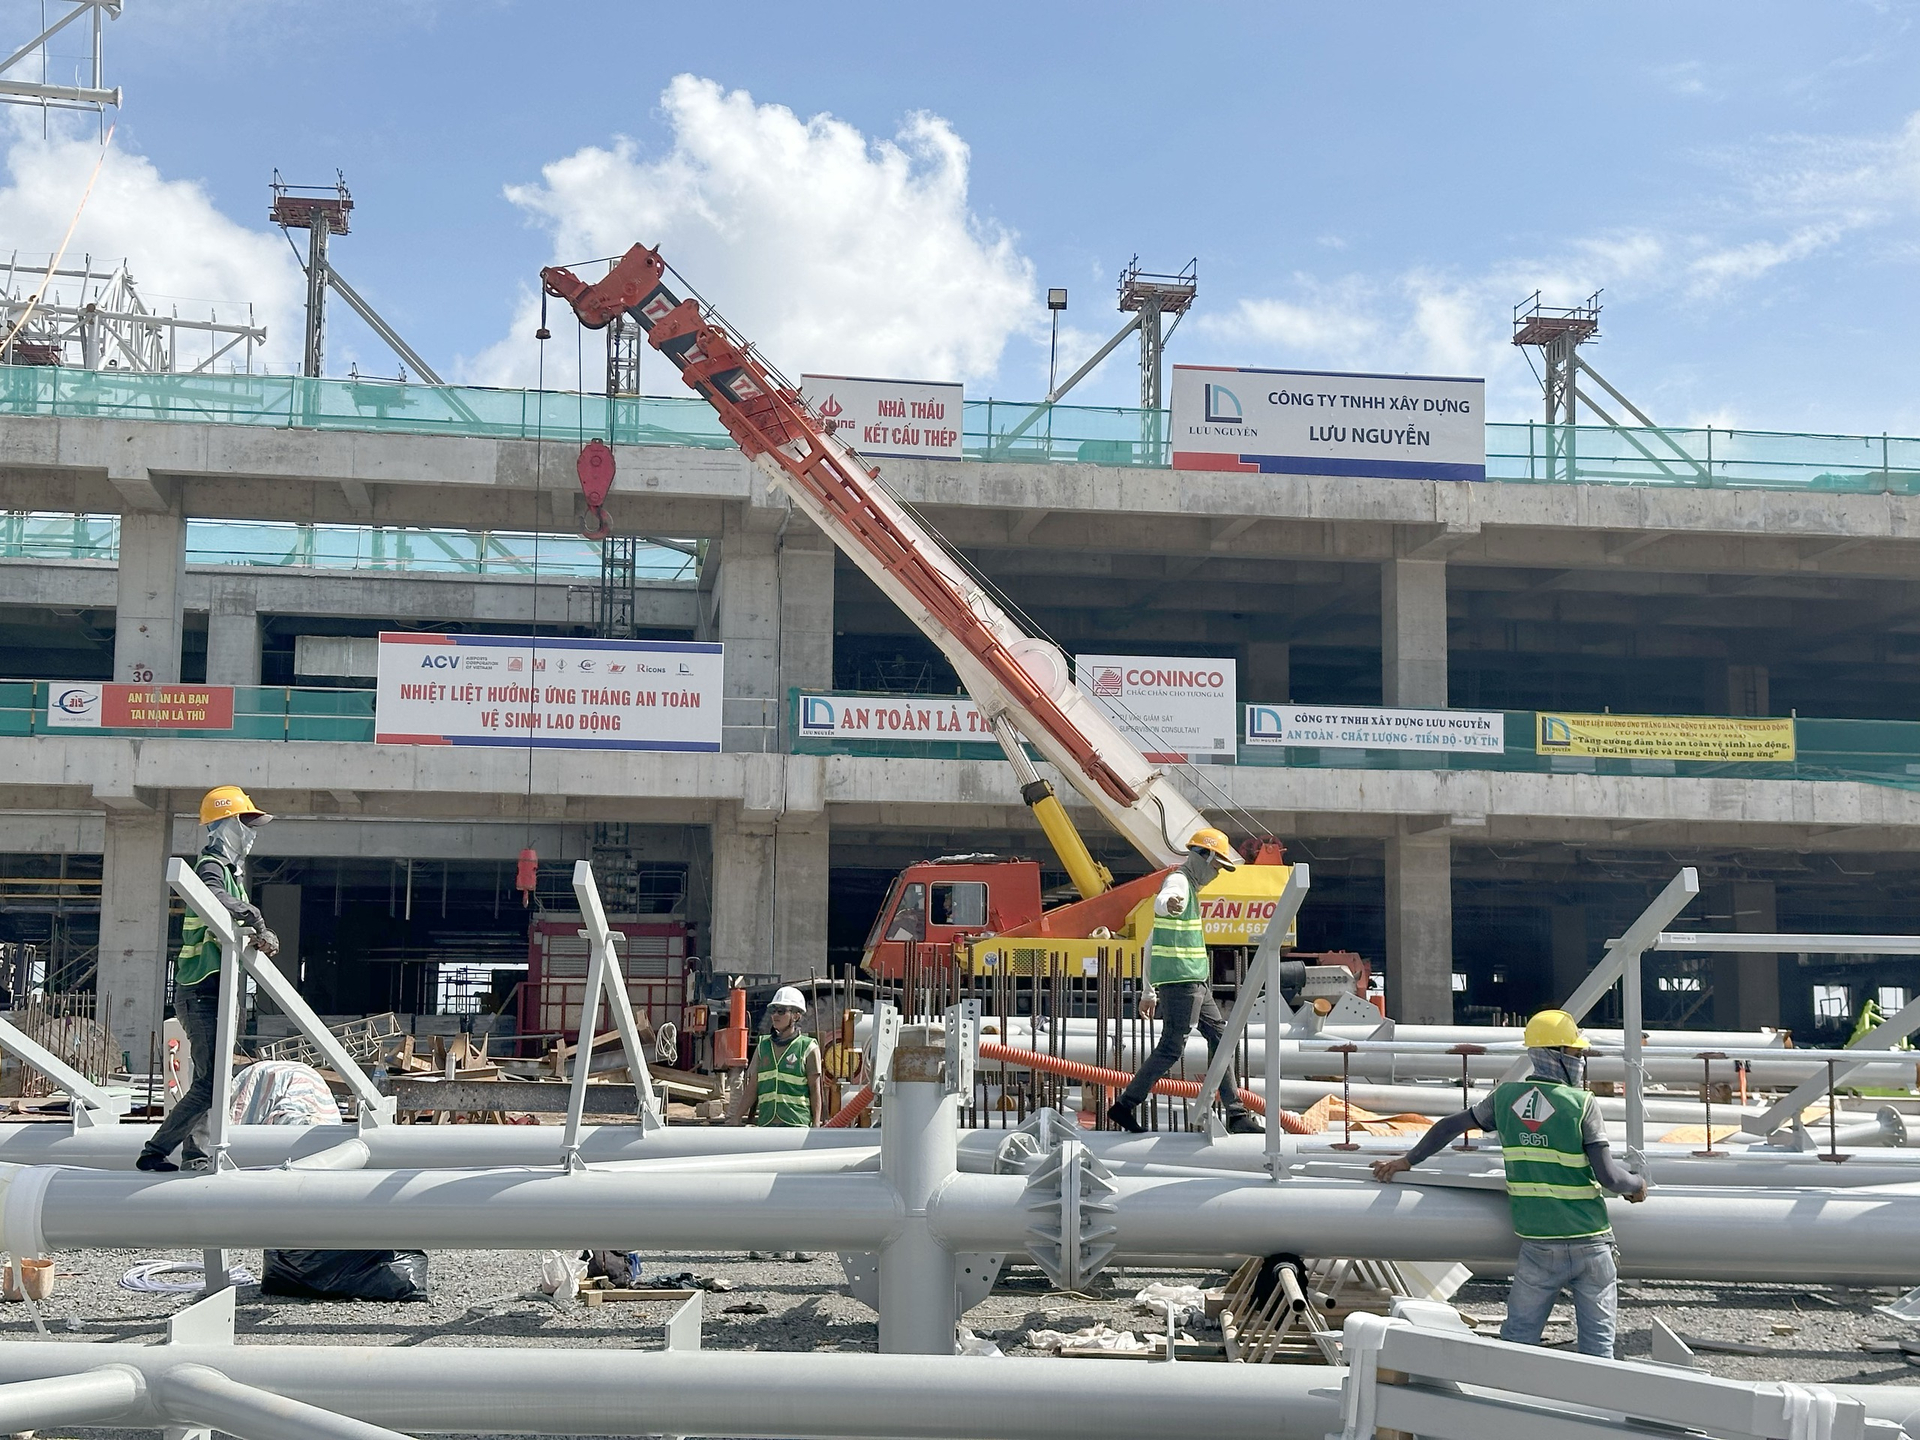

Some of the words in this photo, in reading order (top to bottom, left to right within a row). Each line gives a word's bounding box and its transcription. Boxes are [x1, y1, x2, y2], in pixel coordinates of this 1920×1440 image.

[878, 398, 906, 418] NHÀ
[910, 397, 945, 420] THẦU
[1268, 389, 1314, 406] CÔNG
[1317, 394, 1337, 407] TY
[1340, 395, 1385, 409] TNHH
[1389, 395, 1419, 411] XÂY
[1424, 398, 1470, 416] DỰNG
[864, 421, 889, 444] KẾT
[892, 422, 920, 445] CẤU
[923, 427, 958, 447] THÉP
[1189, 425, 1211, 435] LƯU
[1309, 424, 1346, 442] LƯU
[1352, 423, 1430, 446] NGUYỄN
[421, 655, 460, 669] ACV
[132, 670, 153, 683] 30
[1126, 669, 1224, 688] CONINCO
[128, 692, 143, 703] AN
[174, 692, 186, 704] LÀ
[188, 694, 209, 707] BẠN
[400, 681, 446, 704] NHIỆT
[450, 682, 483, 705] LIỆT
[487, 681, 540, 704] HƯỞNG
[545, 684, 576, 705] ỨNG
[581, 686, 631, 706] THÁNG
[635, 691, 656, 707] AN
[661, 689, 701, 708] TOÀN
[130, 709, 145, 720] TAI
[148, 710, 169, 722] NẠN
[172, 708, 185, 720] LÀ
[186, 708, 206, 721] THÙ
[481, 708, 499, 731] VỆ
[504, 712, 542, 729] SINH
[546, 713, 574, 730] LAO
[579, 711, 621, 733] ĐỘNG
[841, 707, 870, 731] AN
[875, 703, 931, 731] TOÀN
[936, 704, 962, 732] LÀ
[1143, 714, 1160, 722] GIÁM
[1161, 714, 1174, 722] SÁT
[1294, 712, 1323, 724] CÔNG
[1325, 715, 1338, 724] TY
[1340, 716, 1369, 725] TNHH
[1371, 715, 1394, 726] XÂY
[1395, 716, 1424, 728] DỰNG
[1426, 717, 1446, 728] LƯU
[1449, 717, 1491, 729] NGUYỄN
[1119, 725, 1160, 733] SUPERVISION
[1161, 726, 1200, 734] CONSULTANT
[1287, 730, 1302, 740] AN
[1304, 728, 1334, 740] TOÀN
[1341, 728, 1370, 742] CHẤT
[1372, 732, 1408, 745] LƯỢNG
[1415, 731, 1440, 744] TIẾN
[1442, 733, 1457, 747] ĐỘ
[1464, 735, 1480, 746] UY
[1481, 735, 1499, 746] TÍN
[1587, 746, 1600, 754] tại
[1602, 746, 1618, 754] nơi
[1639, 746, 1659, 756] việc
[1674, 749, 1701, 757] trong
[1702, 748, 1729, 758] chuỗi
[1689, 740, 1710, 748] toàn
[1712, 741, 1723, 750] vệ
[1725, 740, 1746, 748] sinh
[1764, 740, 1790, 750] động,
[1200, 898, 1243, 919] TÂN
[1519, 1132, 1549, 1147] CC1
